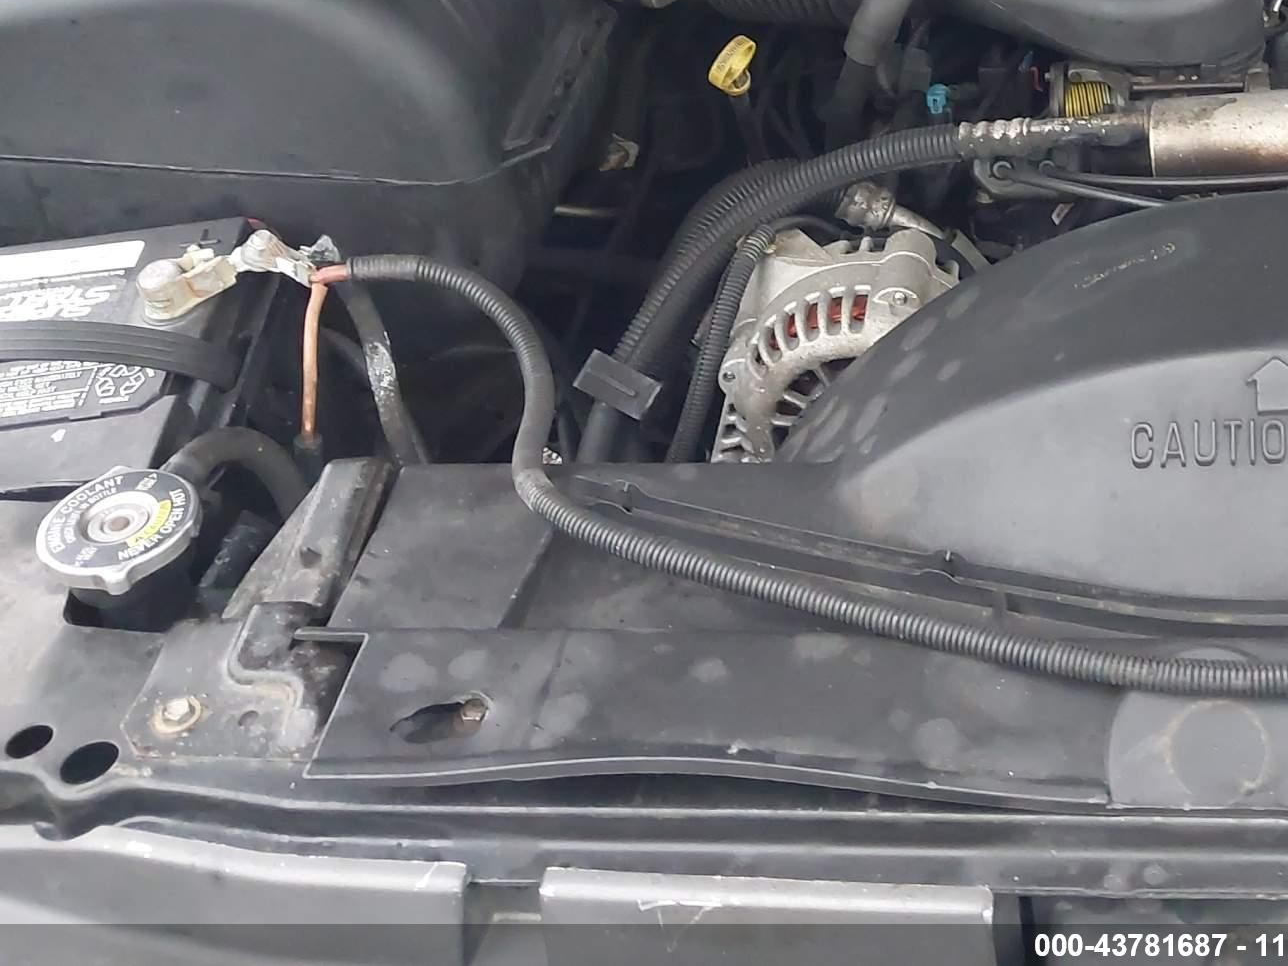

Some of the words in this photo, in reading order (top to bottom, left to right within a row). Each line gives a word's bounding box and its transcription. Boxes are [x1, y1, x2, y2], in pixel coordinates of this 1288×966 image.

[60, 475, 124, 515] COOLANT
[168, 488, 187, 508] HOT
[159, 507, 185, 534] OPEN
[117, 533, 164, 561] NEVER
